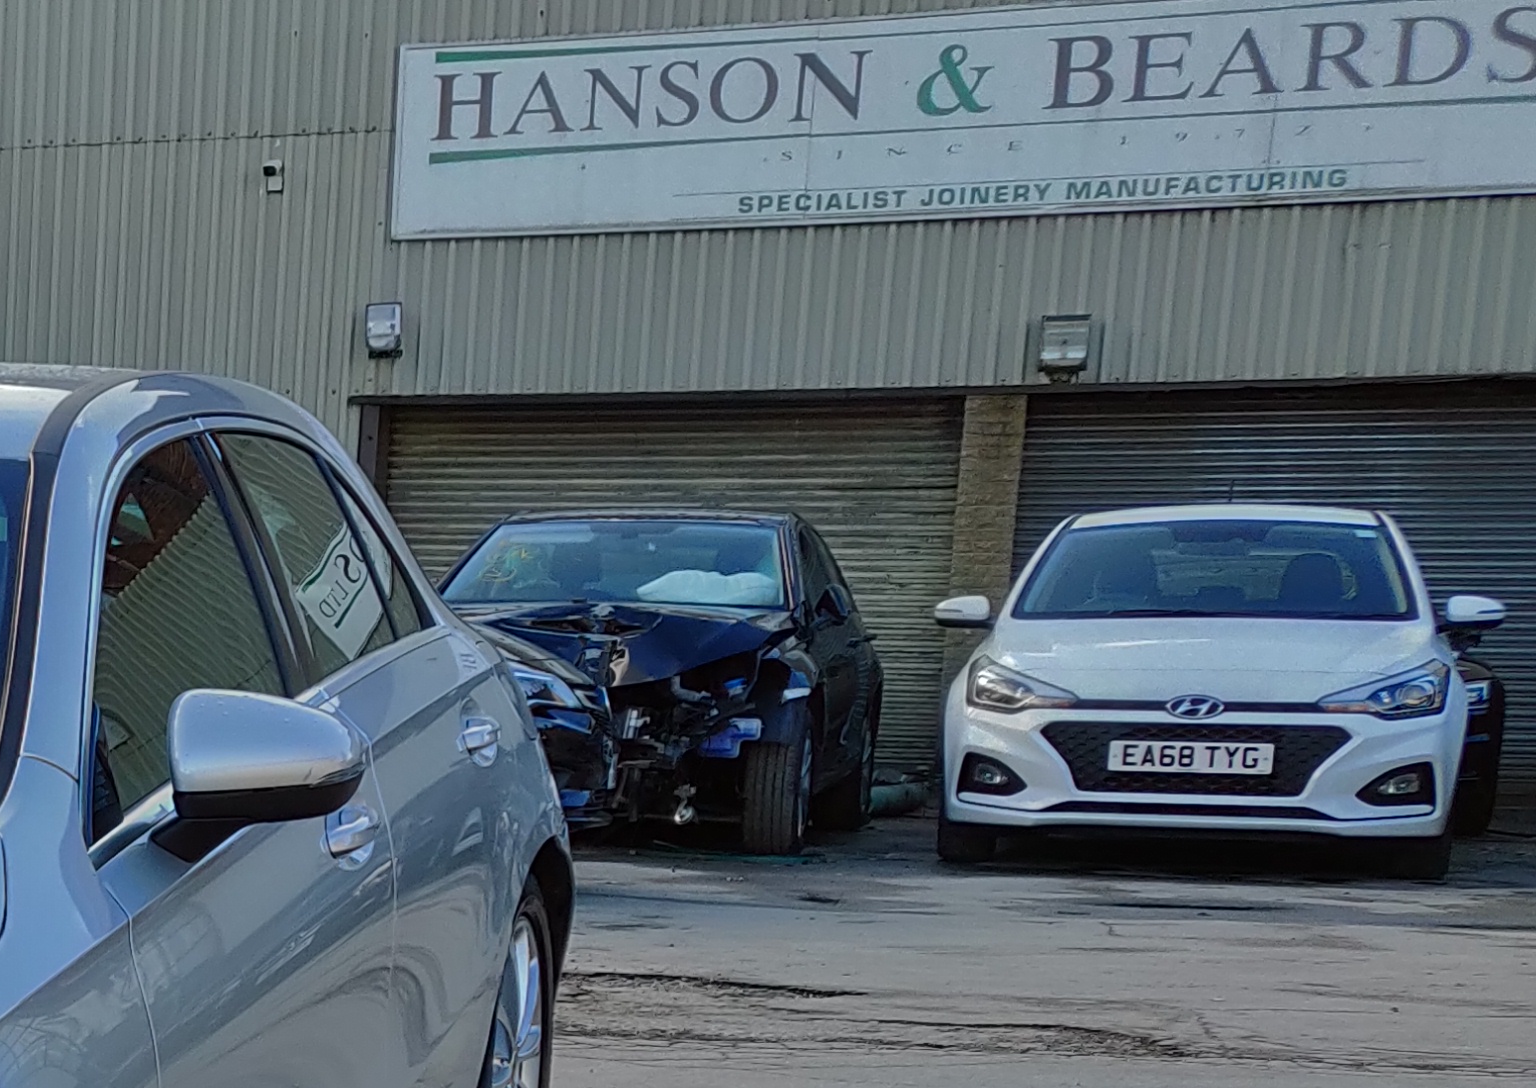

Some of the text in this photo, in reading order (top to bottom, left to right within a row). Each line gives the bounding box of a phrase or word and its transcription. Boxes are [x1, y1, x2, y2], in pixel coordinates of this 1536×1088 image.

[430, 6, 1536, 141] HANSON & BEARDS
[737, 169, 1349, 214] SPECIALIST JOINERY MANUFACTURING
[1121, 744, 1260, 769] EA68 TYG
